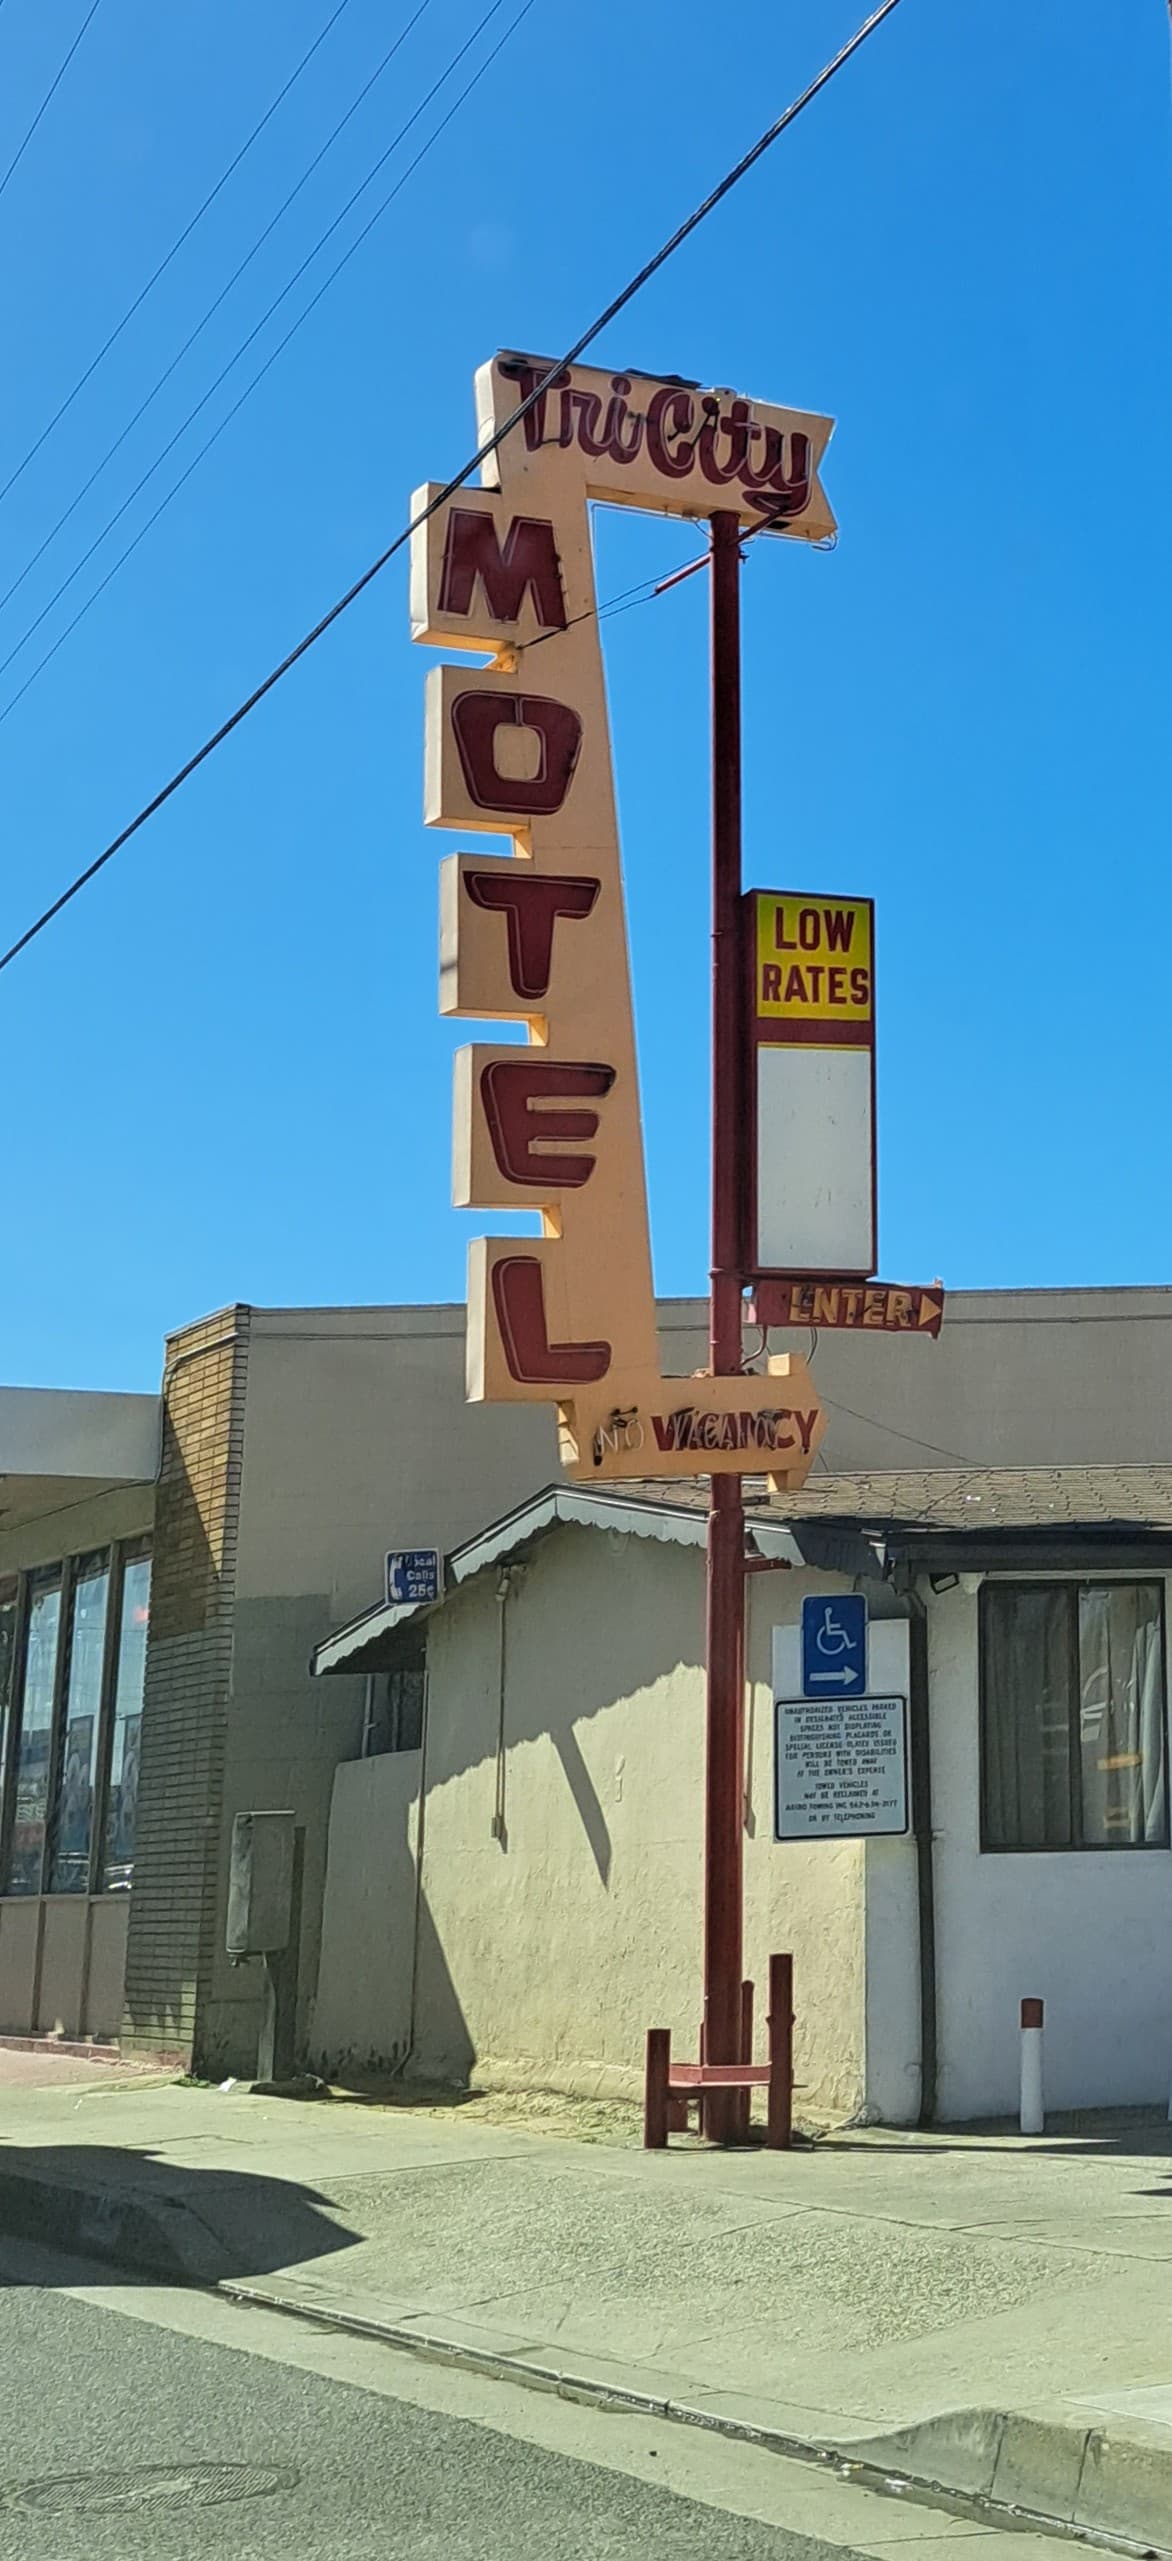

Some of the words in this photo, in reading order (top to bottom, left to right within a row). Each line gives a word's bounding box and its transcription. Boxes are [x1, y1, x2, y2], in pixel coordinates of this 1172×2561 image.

[437, 506, 617, 1385] MOTEL
[775, 906, 855, 953] LOW
[762, 963, 869, 1006] RATES
[789, 1285, 912, 1328] ENTER
[651, 1408, 819, 1452] VACANCY
